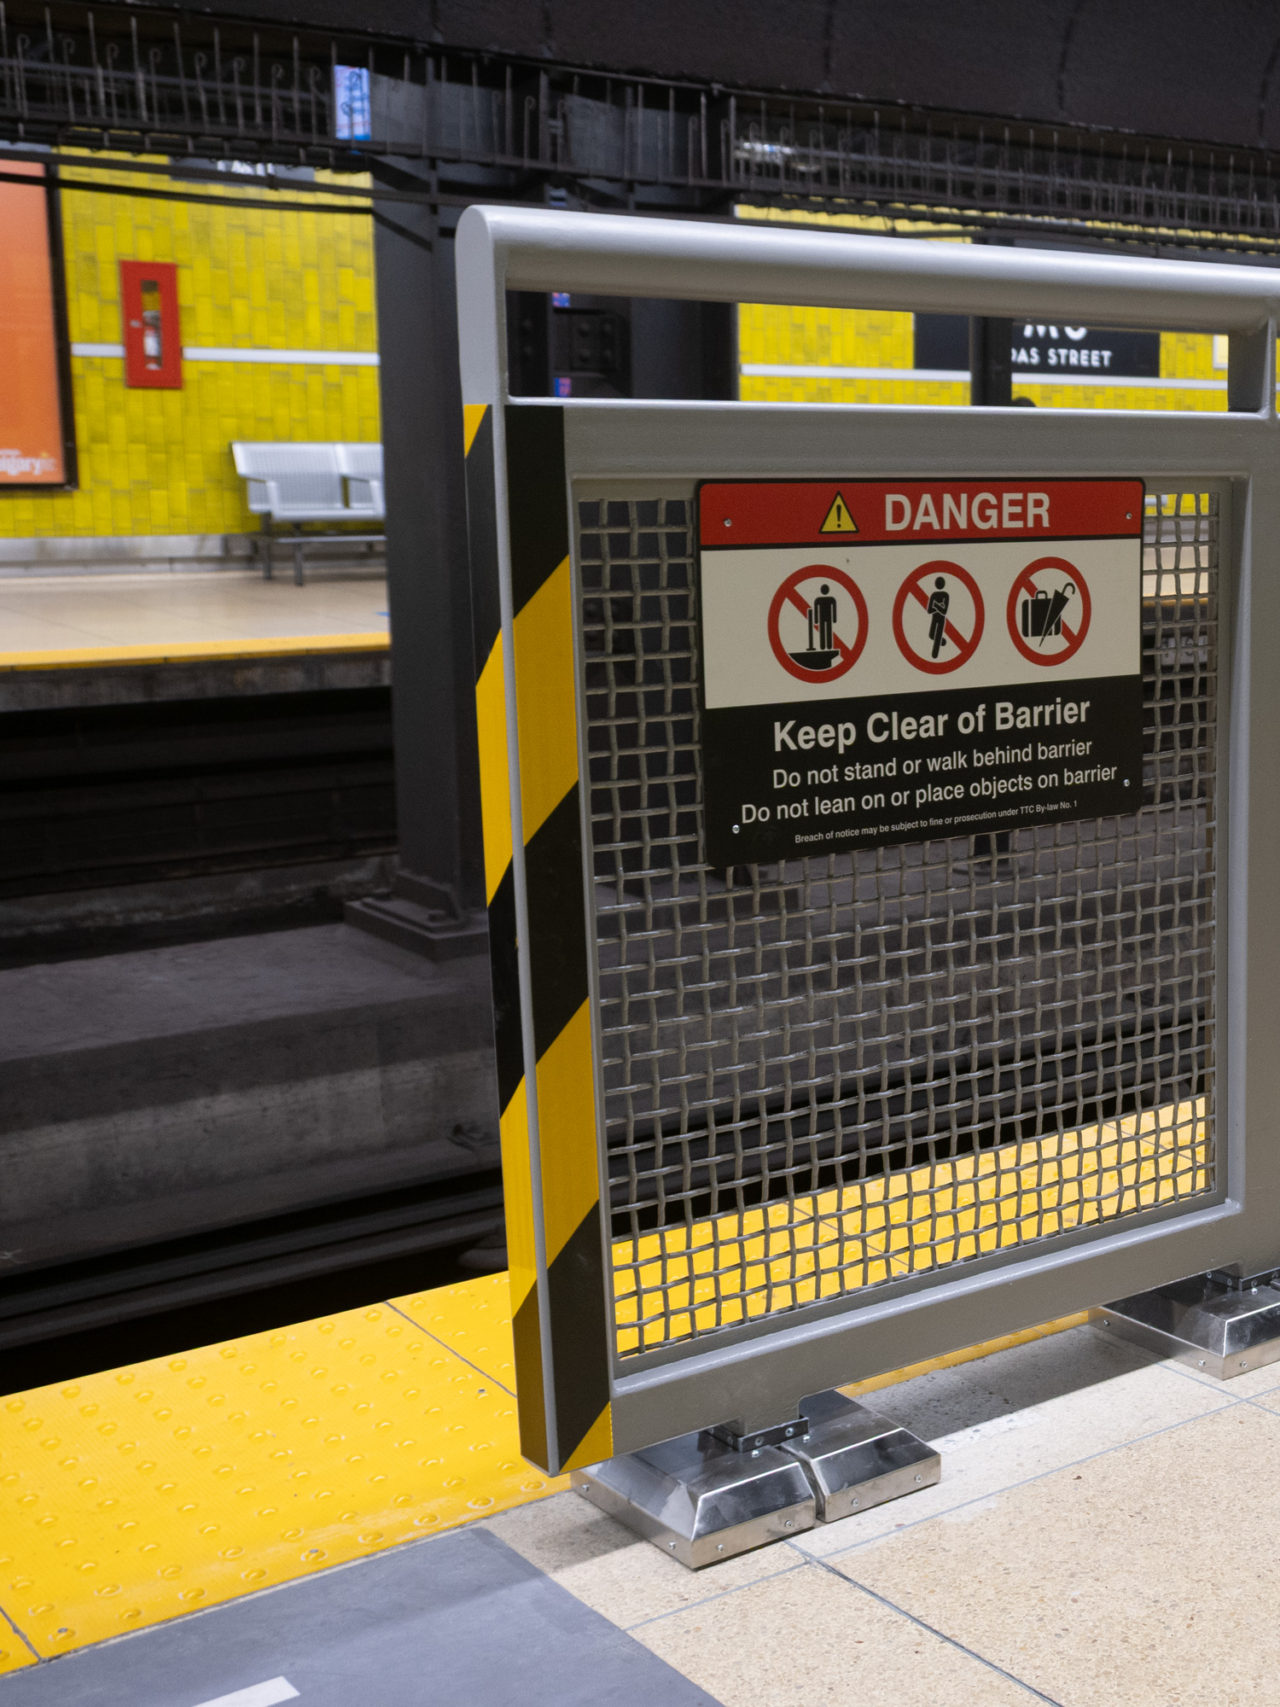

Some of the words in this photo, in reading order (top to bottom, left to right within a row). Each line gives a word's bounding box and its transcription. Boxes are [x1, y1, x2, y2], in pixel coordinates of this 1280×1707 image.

[1011, 347, 1041, 366] AS
[1048, 348, 1112, 368] STREET
[885, 492, 1050, 531] DANGER
[773, 720, 857, 755] Keep
[866, 711, 949, 743] Clear
[957, 703, 987, 735] of
[995, 696, 1091, 731] Barrier
[772, 768, 801, 789] Do
[807, 764, 839, 785] not
[844, 757, 897, 782] stand
[902, 758, 922, 775] or
[926, 750, 968, 772] walk
[973, 743, 1033, 768] behind
[1037, 738, 1093, 760] barrier
[741, 803, 771, 824] Do
[776, 798, 809, 820] not
[814, 796, 856, 816] lean
[861, 793, 885, 810] on
[890, 790, 911, 807] or
[915, 783, 965, 809] place
[969, 774, 1033, 800] objects
[1037, 773, 1059, 789] on
[1063, 764, 1118, 786] barrier
[794, 832, 824, 844] Breach
[825, 830, 834, 840] of
[834, 828, 860, 839] notice
[860, 826, 878, 836] may
[878, 824, 890, 833] be
[890, 820, 919, 832] subject
[919, 820, 928, 828] to
[928, 817, 944, 826] fine
[944, 817, 953, 825] or
[953, 811, 997, 825] prosecution
[997, 807, 1019, 818] under
[1019, 804, 1035, 815] TTC
[1035, 802, 1059, 814] By-law
